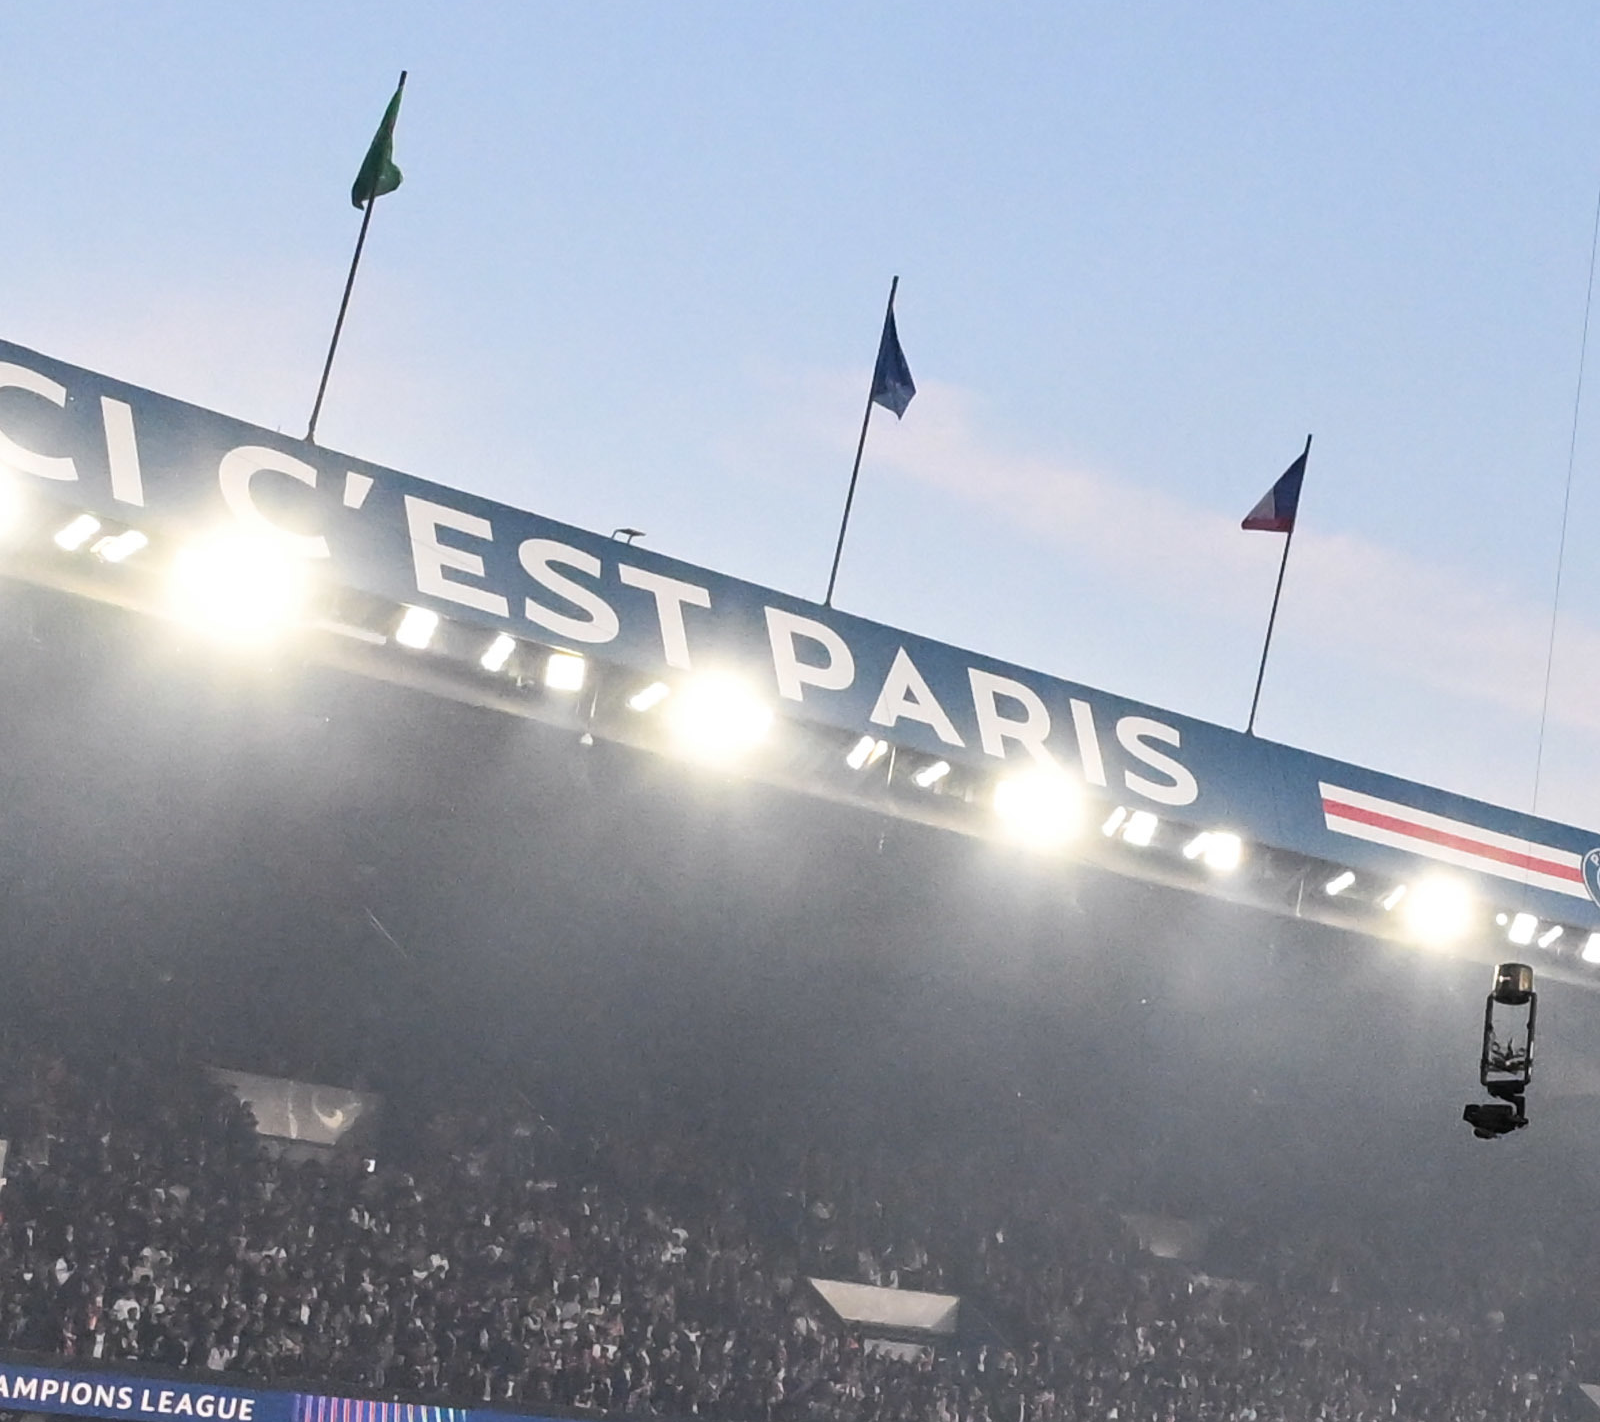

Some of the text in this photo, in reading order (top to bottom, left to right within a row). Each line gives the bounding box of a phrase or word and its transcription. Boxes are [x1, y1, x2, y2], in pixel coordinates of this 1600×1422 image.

[219, 445, 711, 670] C'EST
[767, 605, 1200, 806] PARIS
[140, 1389, 255, 1421] LEAGUE
